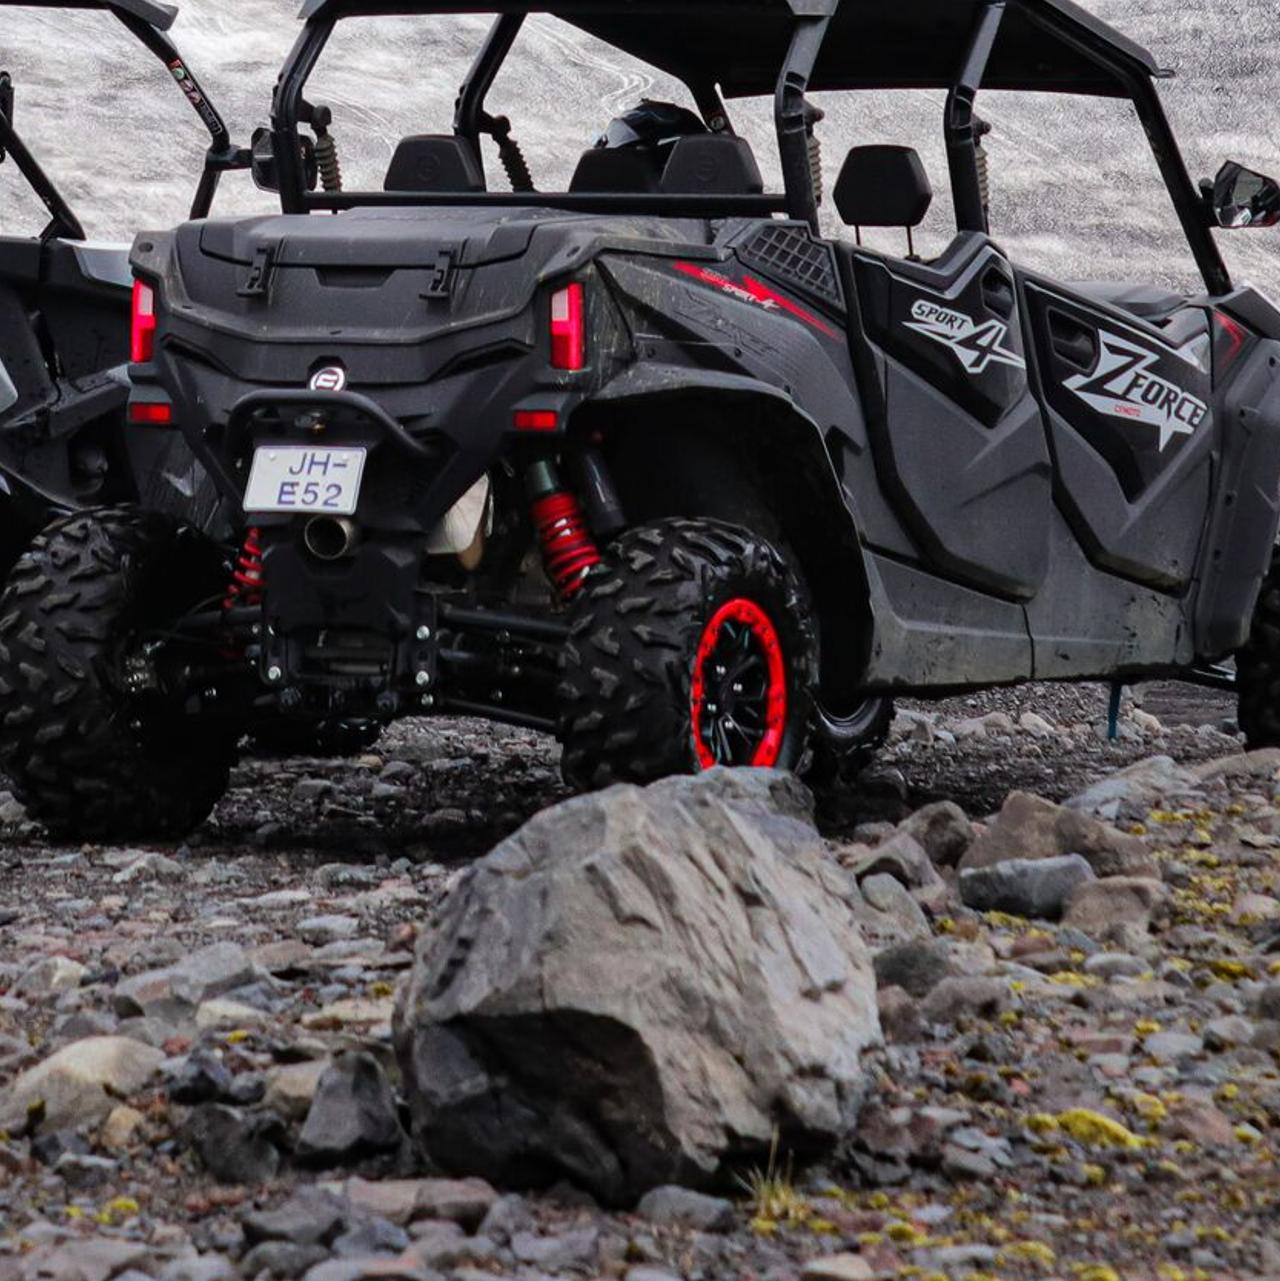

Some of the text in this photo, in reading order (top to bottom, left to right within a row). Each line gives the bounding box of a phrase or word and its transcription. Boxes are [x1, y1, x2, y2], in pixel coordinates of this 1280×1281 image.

[914, 302, 1021, 368] SPORT 4
[277, 481, 342, 507] E52
